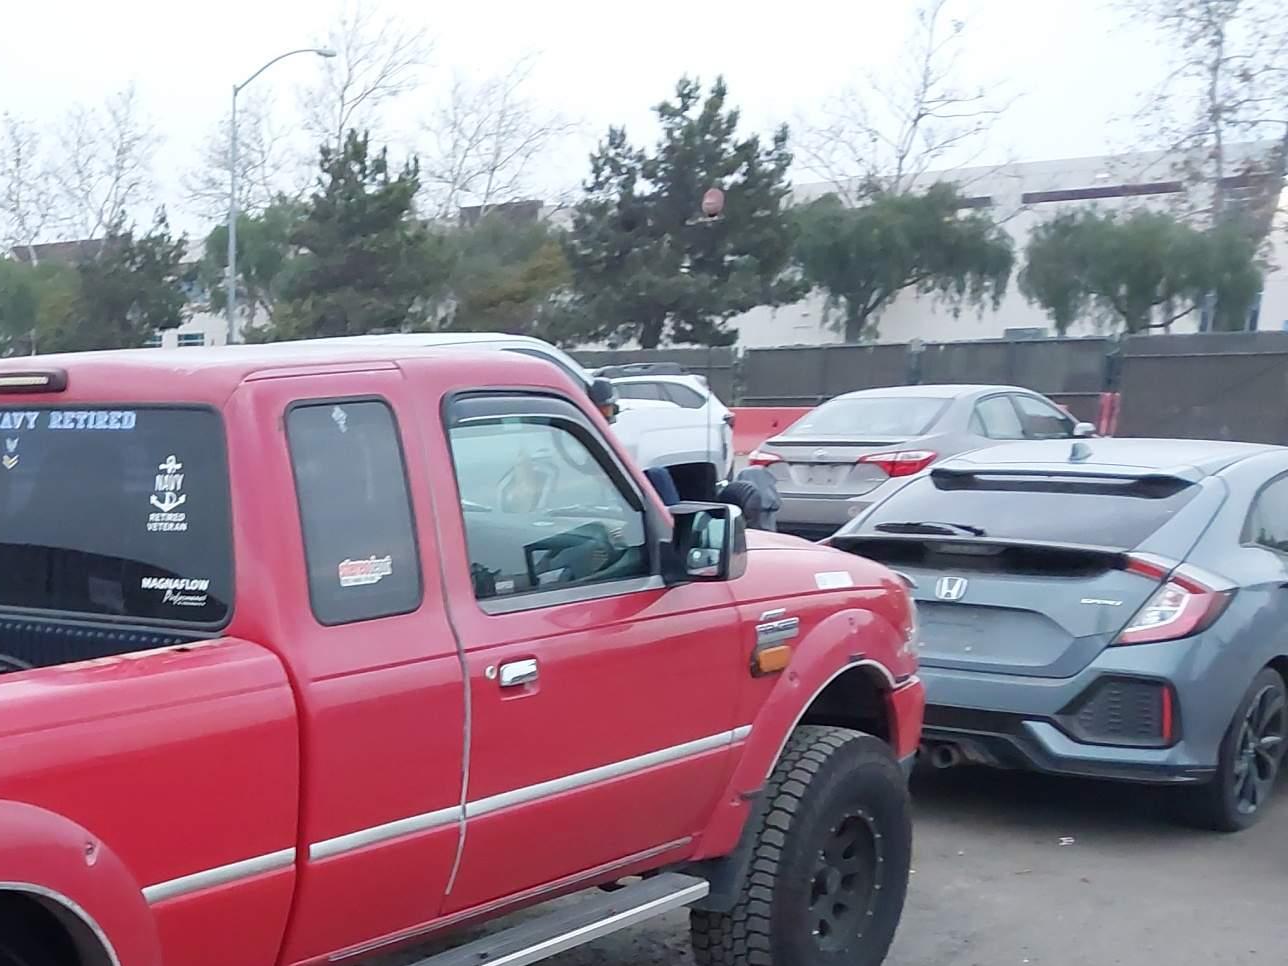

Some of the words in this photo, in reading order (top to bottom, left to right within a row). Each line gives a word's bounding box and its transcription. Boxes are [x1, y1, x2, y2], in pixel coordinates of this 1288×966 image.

[47, 410, 137, 430] RETIRED
[154, 473, 185, 492] NAVY
[148, 512, 186, 522] RETIRED
[146, 522, 188, 532] VETERAN
[141, 577, 210, 591] MAGNAFLOW
